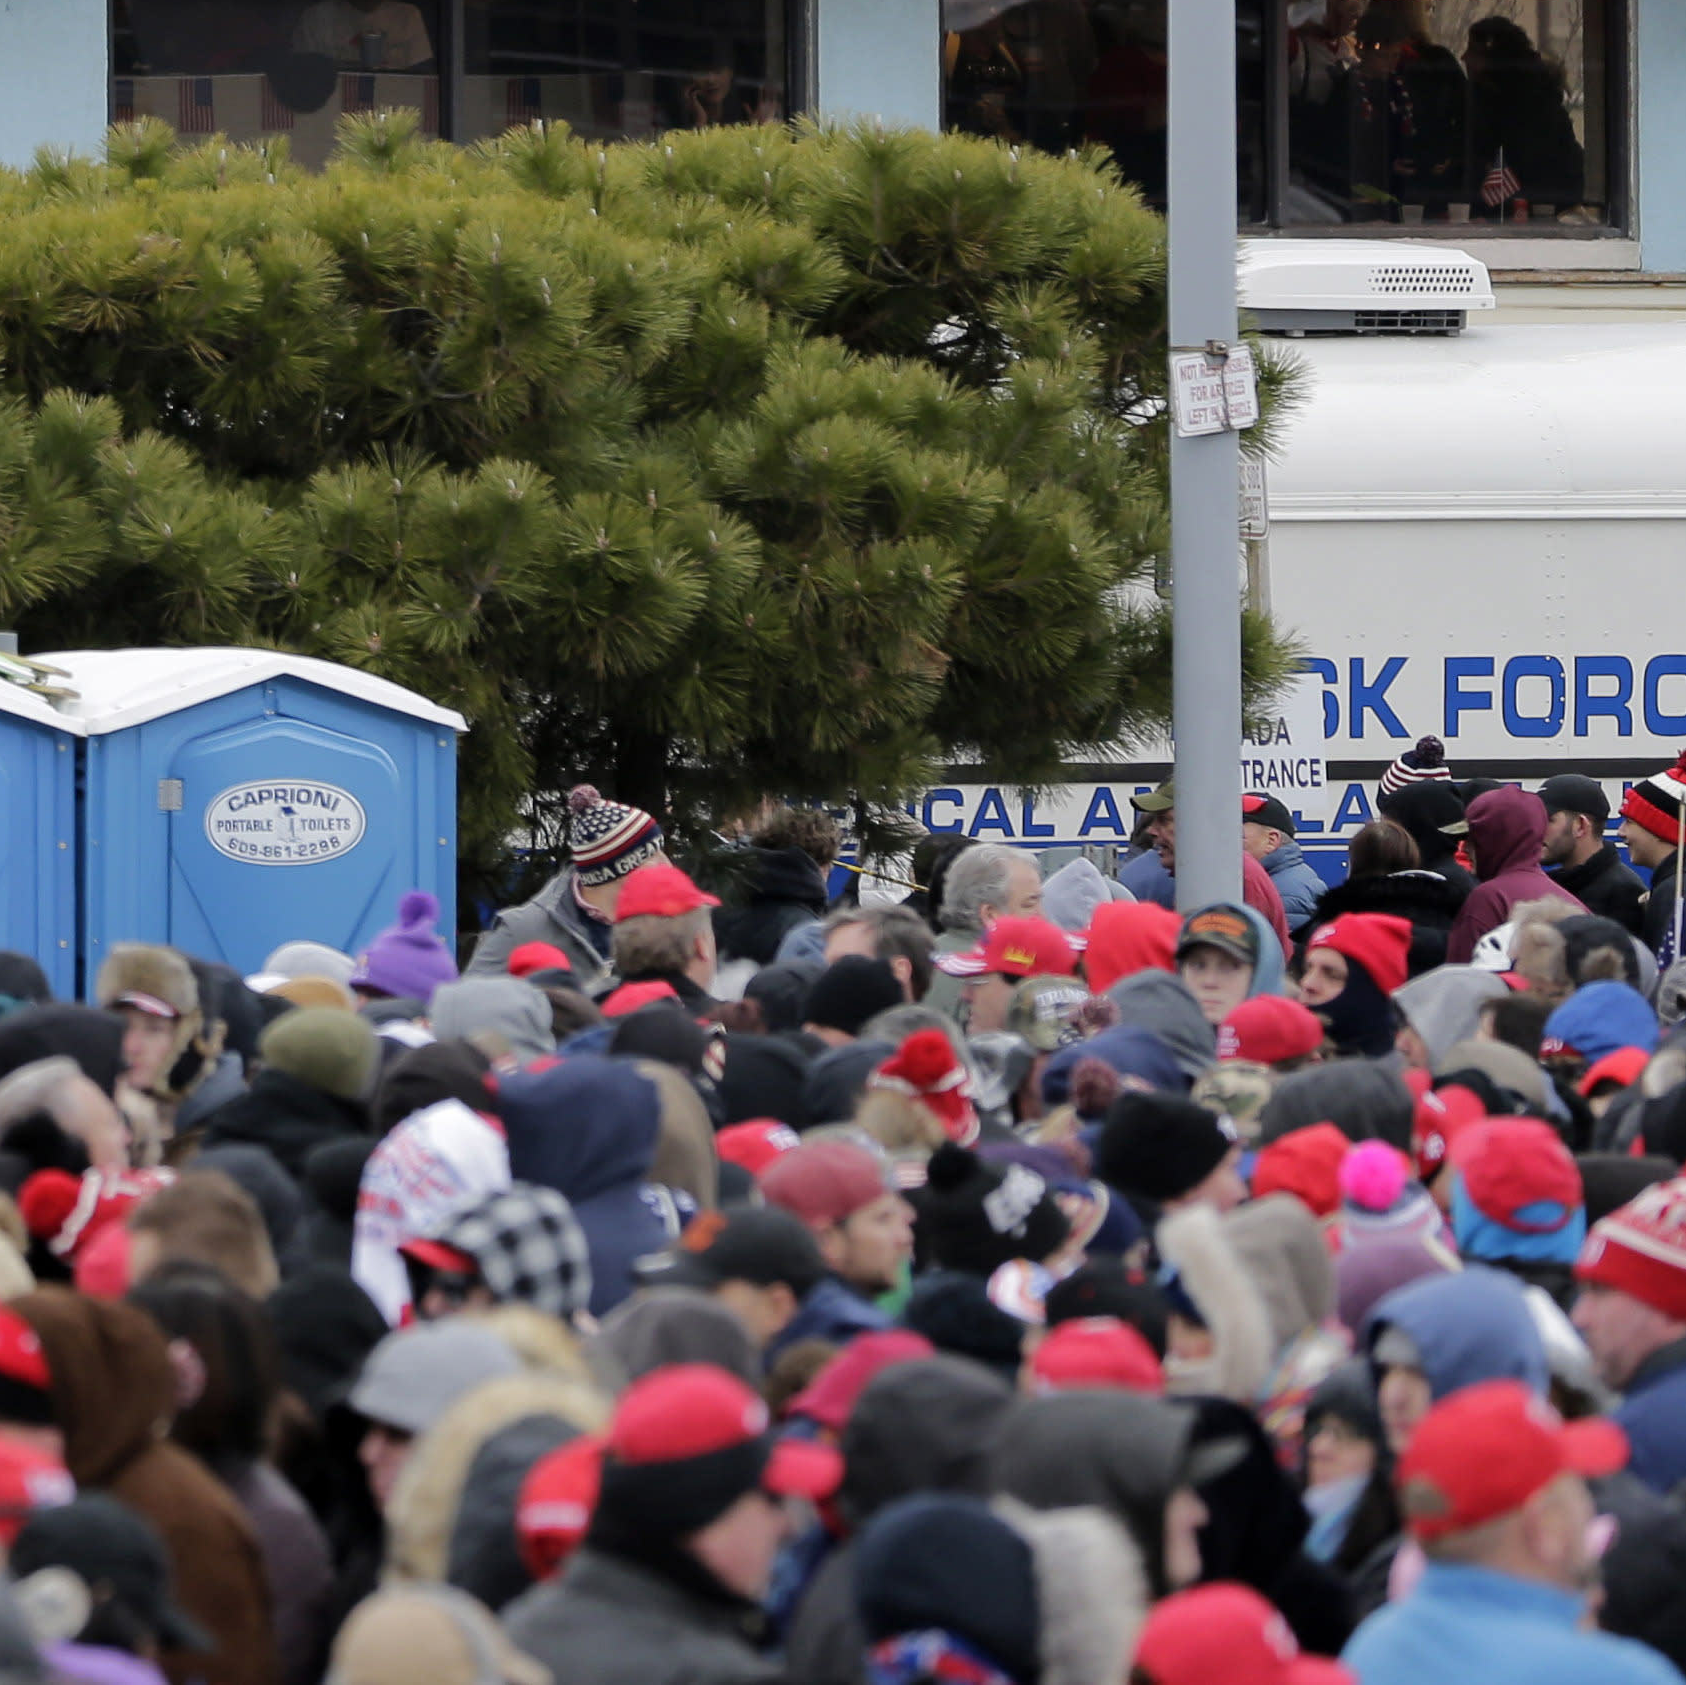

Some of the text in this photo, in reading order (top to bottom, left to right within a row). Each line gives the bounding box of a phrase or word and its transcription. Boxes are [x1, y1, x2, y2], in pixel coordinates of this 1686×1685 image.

[228, 788, 341, 812] CAPRIONI
[217, 818, 351, 832] PORTABLE TOILETS
